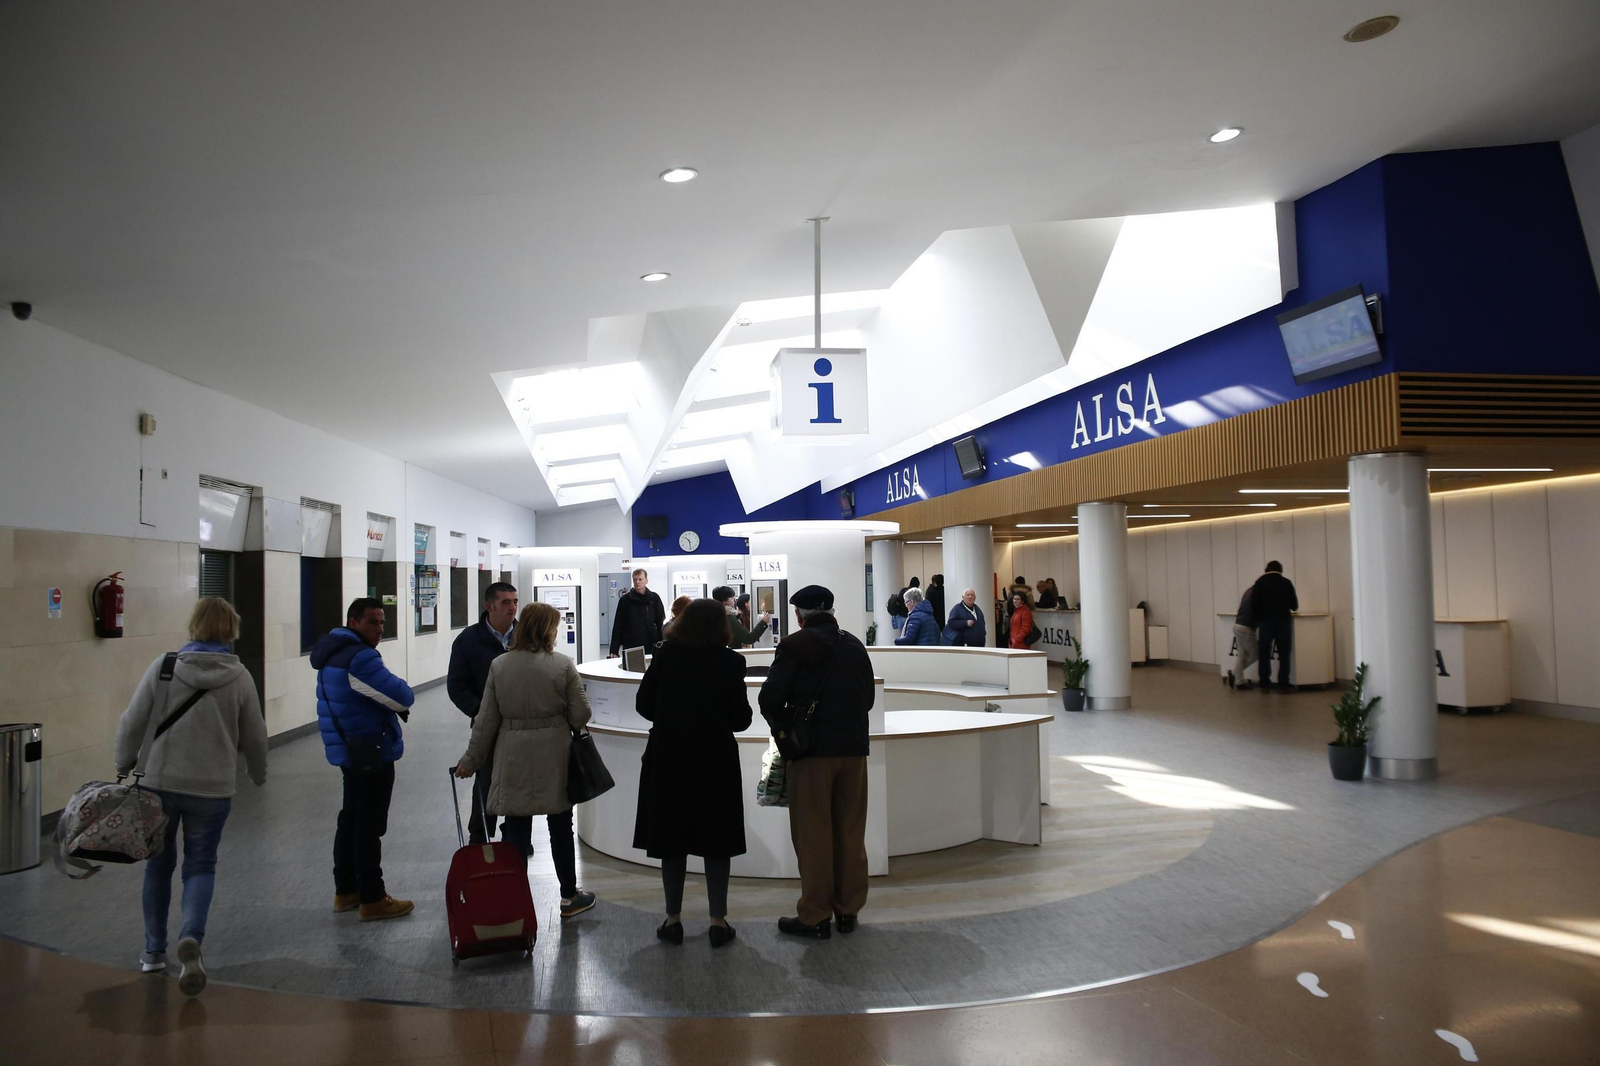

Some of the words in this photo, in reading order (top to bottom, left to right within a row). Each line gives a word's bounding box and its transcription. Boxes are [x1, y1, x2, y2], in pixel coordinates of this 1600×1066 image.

[1071, 373, 1166, 449] ALSA
[886, 464, 920, 504] ALSA
[757, 561, 781, 572] ALSA
[543, 573, 573, 582] ALSA
[727, 573, 744, 581] LSA
[1042, 627, 1073, 647] ALSA
